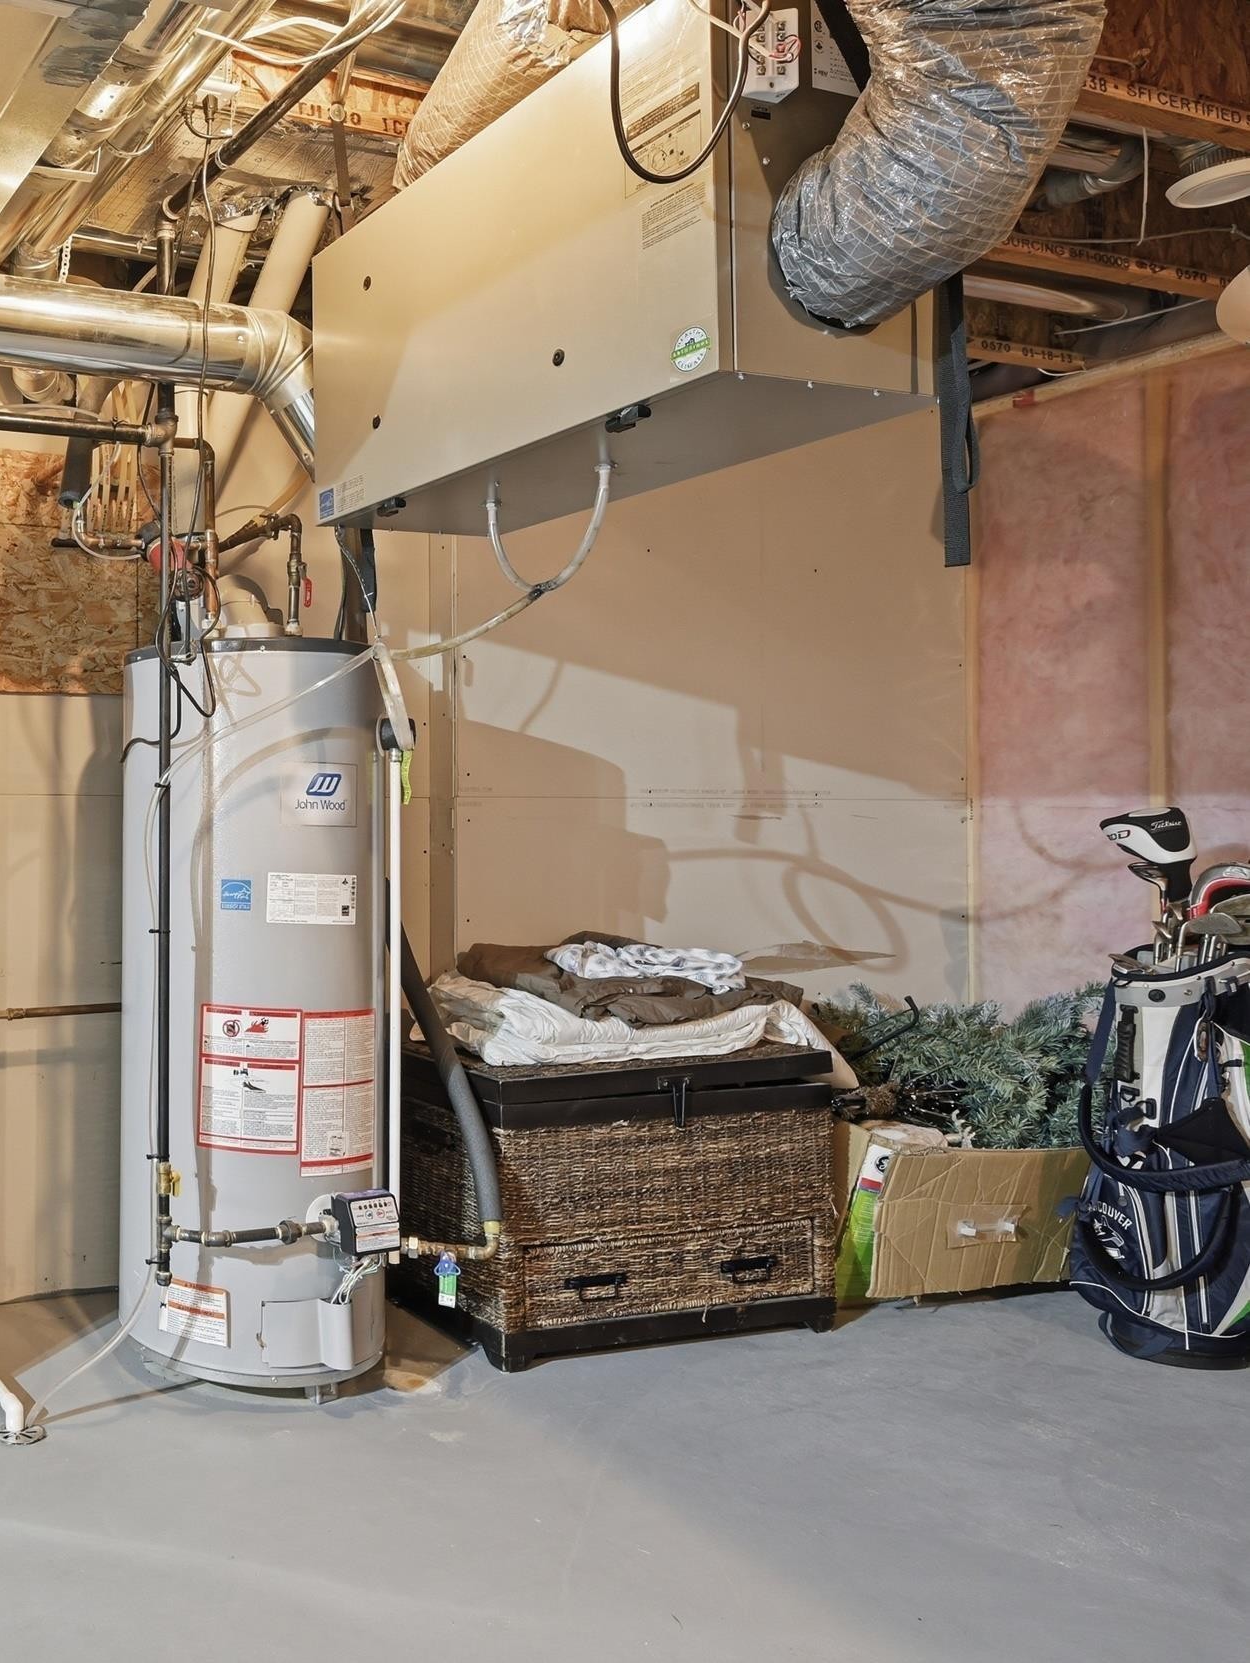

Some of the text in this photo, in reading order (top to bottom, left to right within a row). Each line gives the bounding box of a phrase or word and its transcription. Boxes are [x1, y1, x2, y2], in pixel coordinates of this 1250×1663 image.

[1127, 83, 1152, 102] SFI
[1157, 91, 1242, 124] CERTIFIED
[295, 799, 346, 811] John Wood
